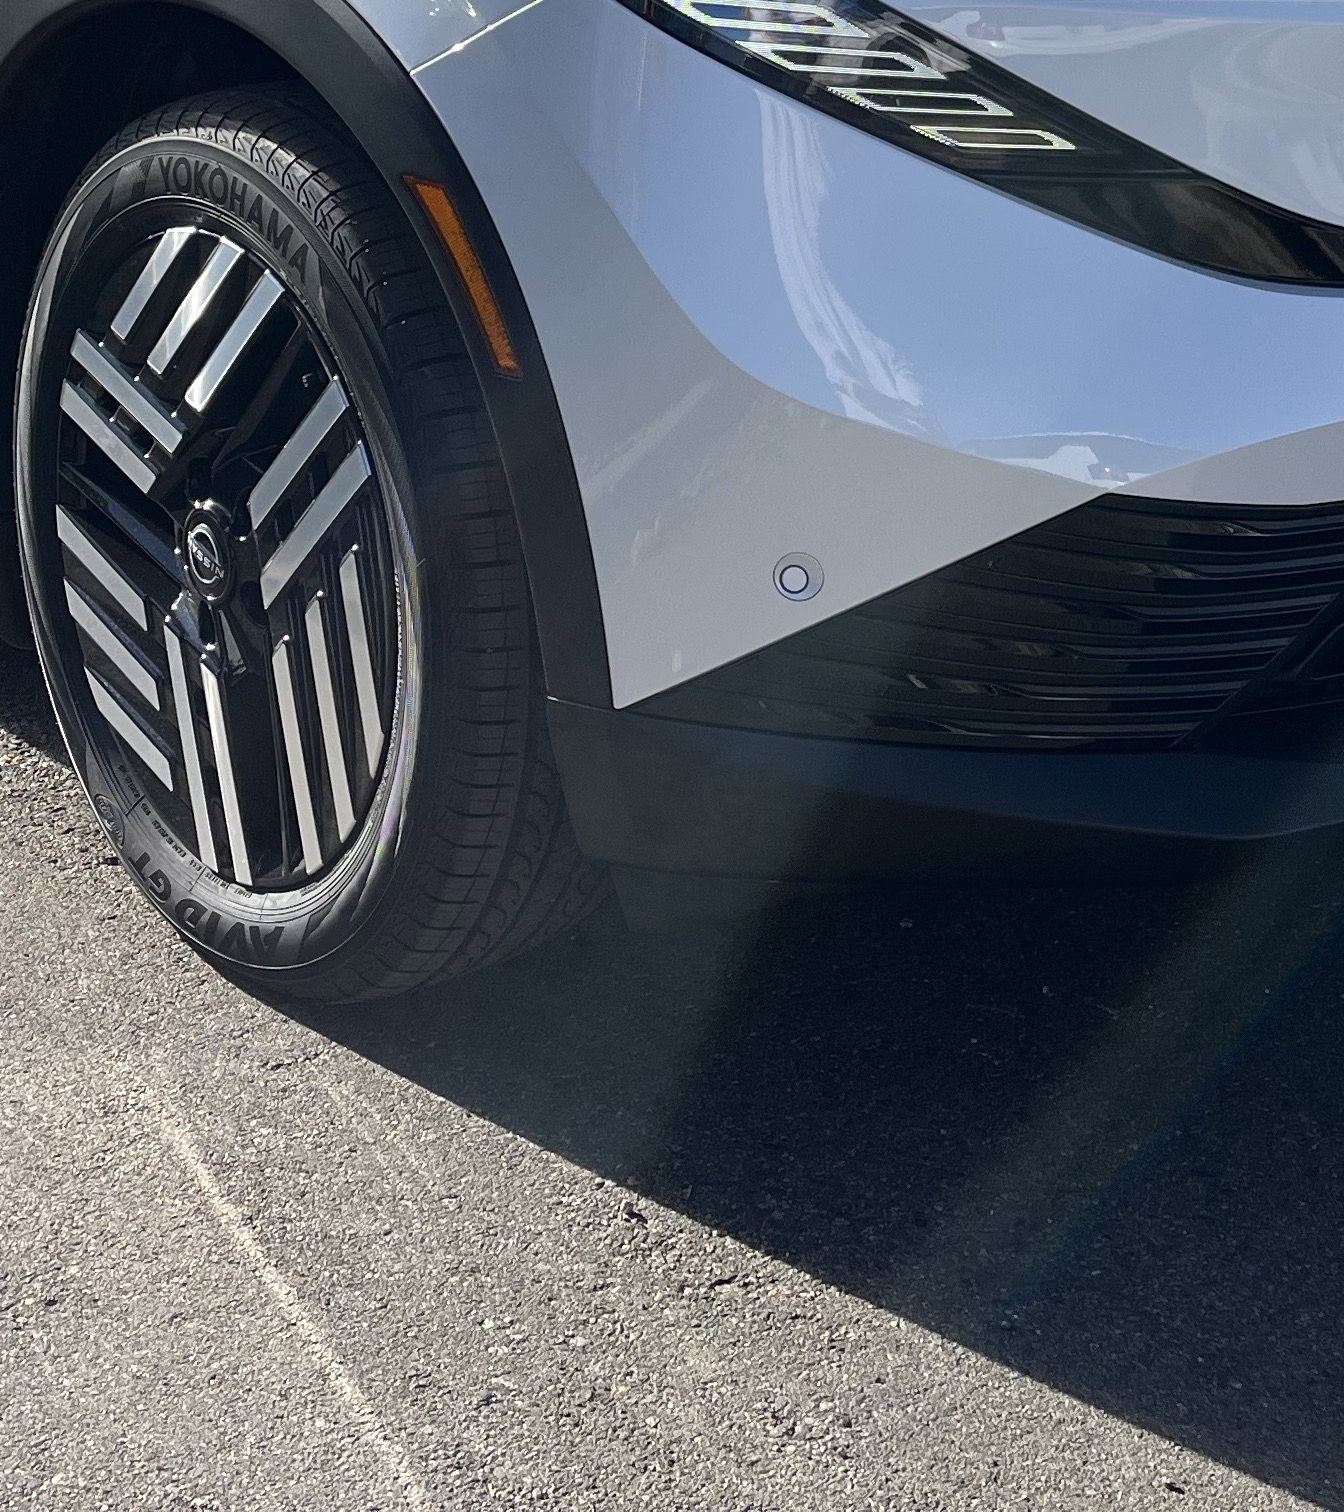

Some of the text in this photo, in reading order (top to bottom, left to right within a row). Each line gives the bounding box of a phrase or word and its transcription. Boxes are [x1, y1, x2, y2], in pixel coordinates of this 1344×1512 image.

[158, 156, 310, 284] YOKOHAMA
[188, 532, 225, 579] NISSA
[128, 851, 173, 904] GT
[175, 898, 286, 958] AVID
